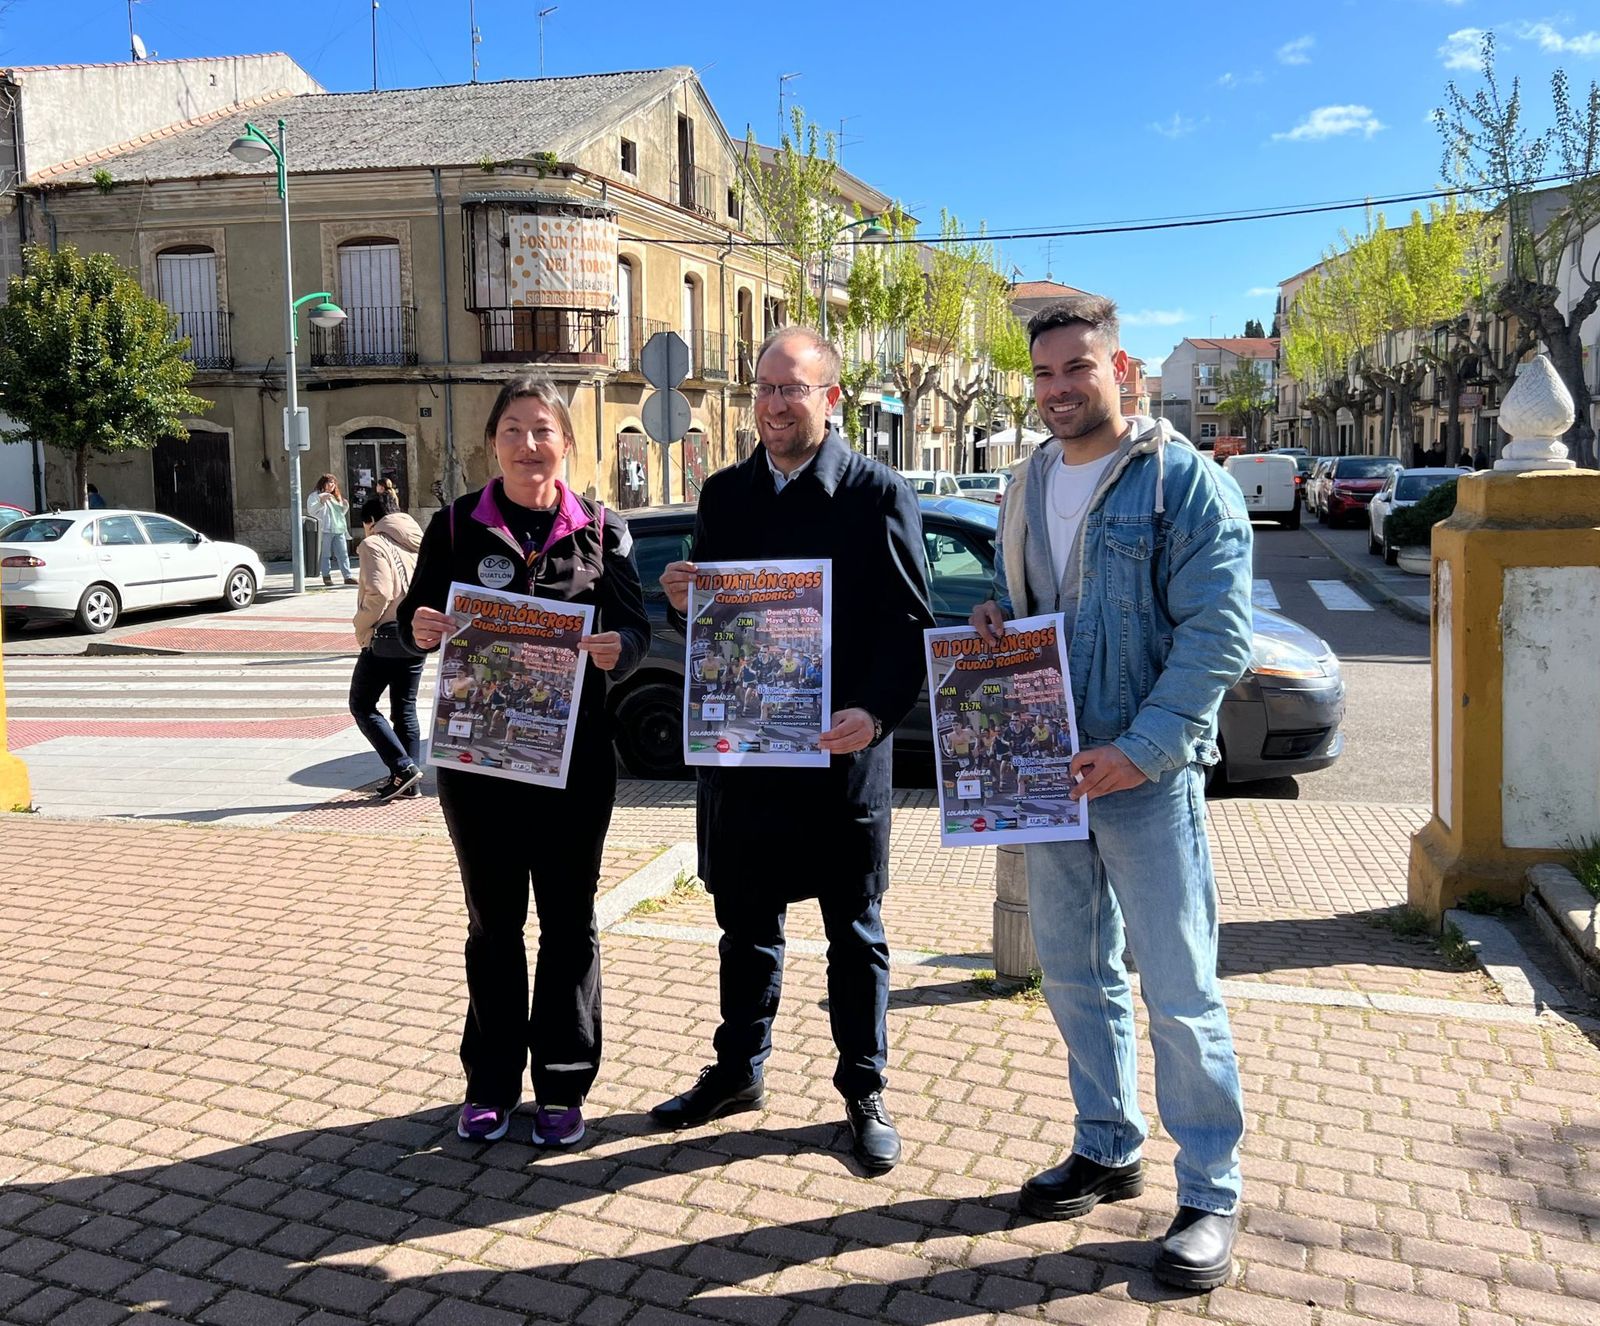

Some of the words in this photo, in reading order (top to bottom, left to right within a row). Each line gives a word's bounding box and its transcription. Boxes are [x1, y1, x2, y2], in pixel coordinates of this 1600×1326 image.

[519, 235, 547, 249] POR
[550, 236, 568, 249] UN
[422, 408, 429, 417] 6
[696, 575, 711, 590] VI
[714, 593, 750, 604] CIUDAD
[750, 590, 796, 603] RODRIGO
[455, 596, 471, 613] VI
[766, 608, 796, 618] Domingo
[696, 617, 713, 625] 4KM
[737, 618, 753, 627] 2KM
[766, 617, 784, 625] Mayo
[800, 616, 819, 624] 2024
[471, 618, 509, 634] CIUDAD
[509, 624, 555, 639] RODRIGO
[450, 639, 468, 648] 4KM
[492, 645, 509, 654] 2KM
[932, 640, 949, 658] VI
[520, 649, 540, 658] Mayo
[556, 654, 575, 663] 2024
[955, 659, 994, 671] CIUDAD
[995, 650, 1035, 668] RODRIGO
[939, 686, 957, 696] 4KM
[983, 685, 1000, 695] 2KM
[1013, 682, 1031, 690] Mayo
[1044, 677, 1060, 686] 2024
[946, 809, 980, 817] COLABORAN
